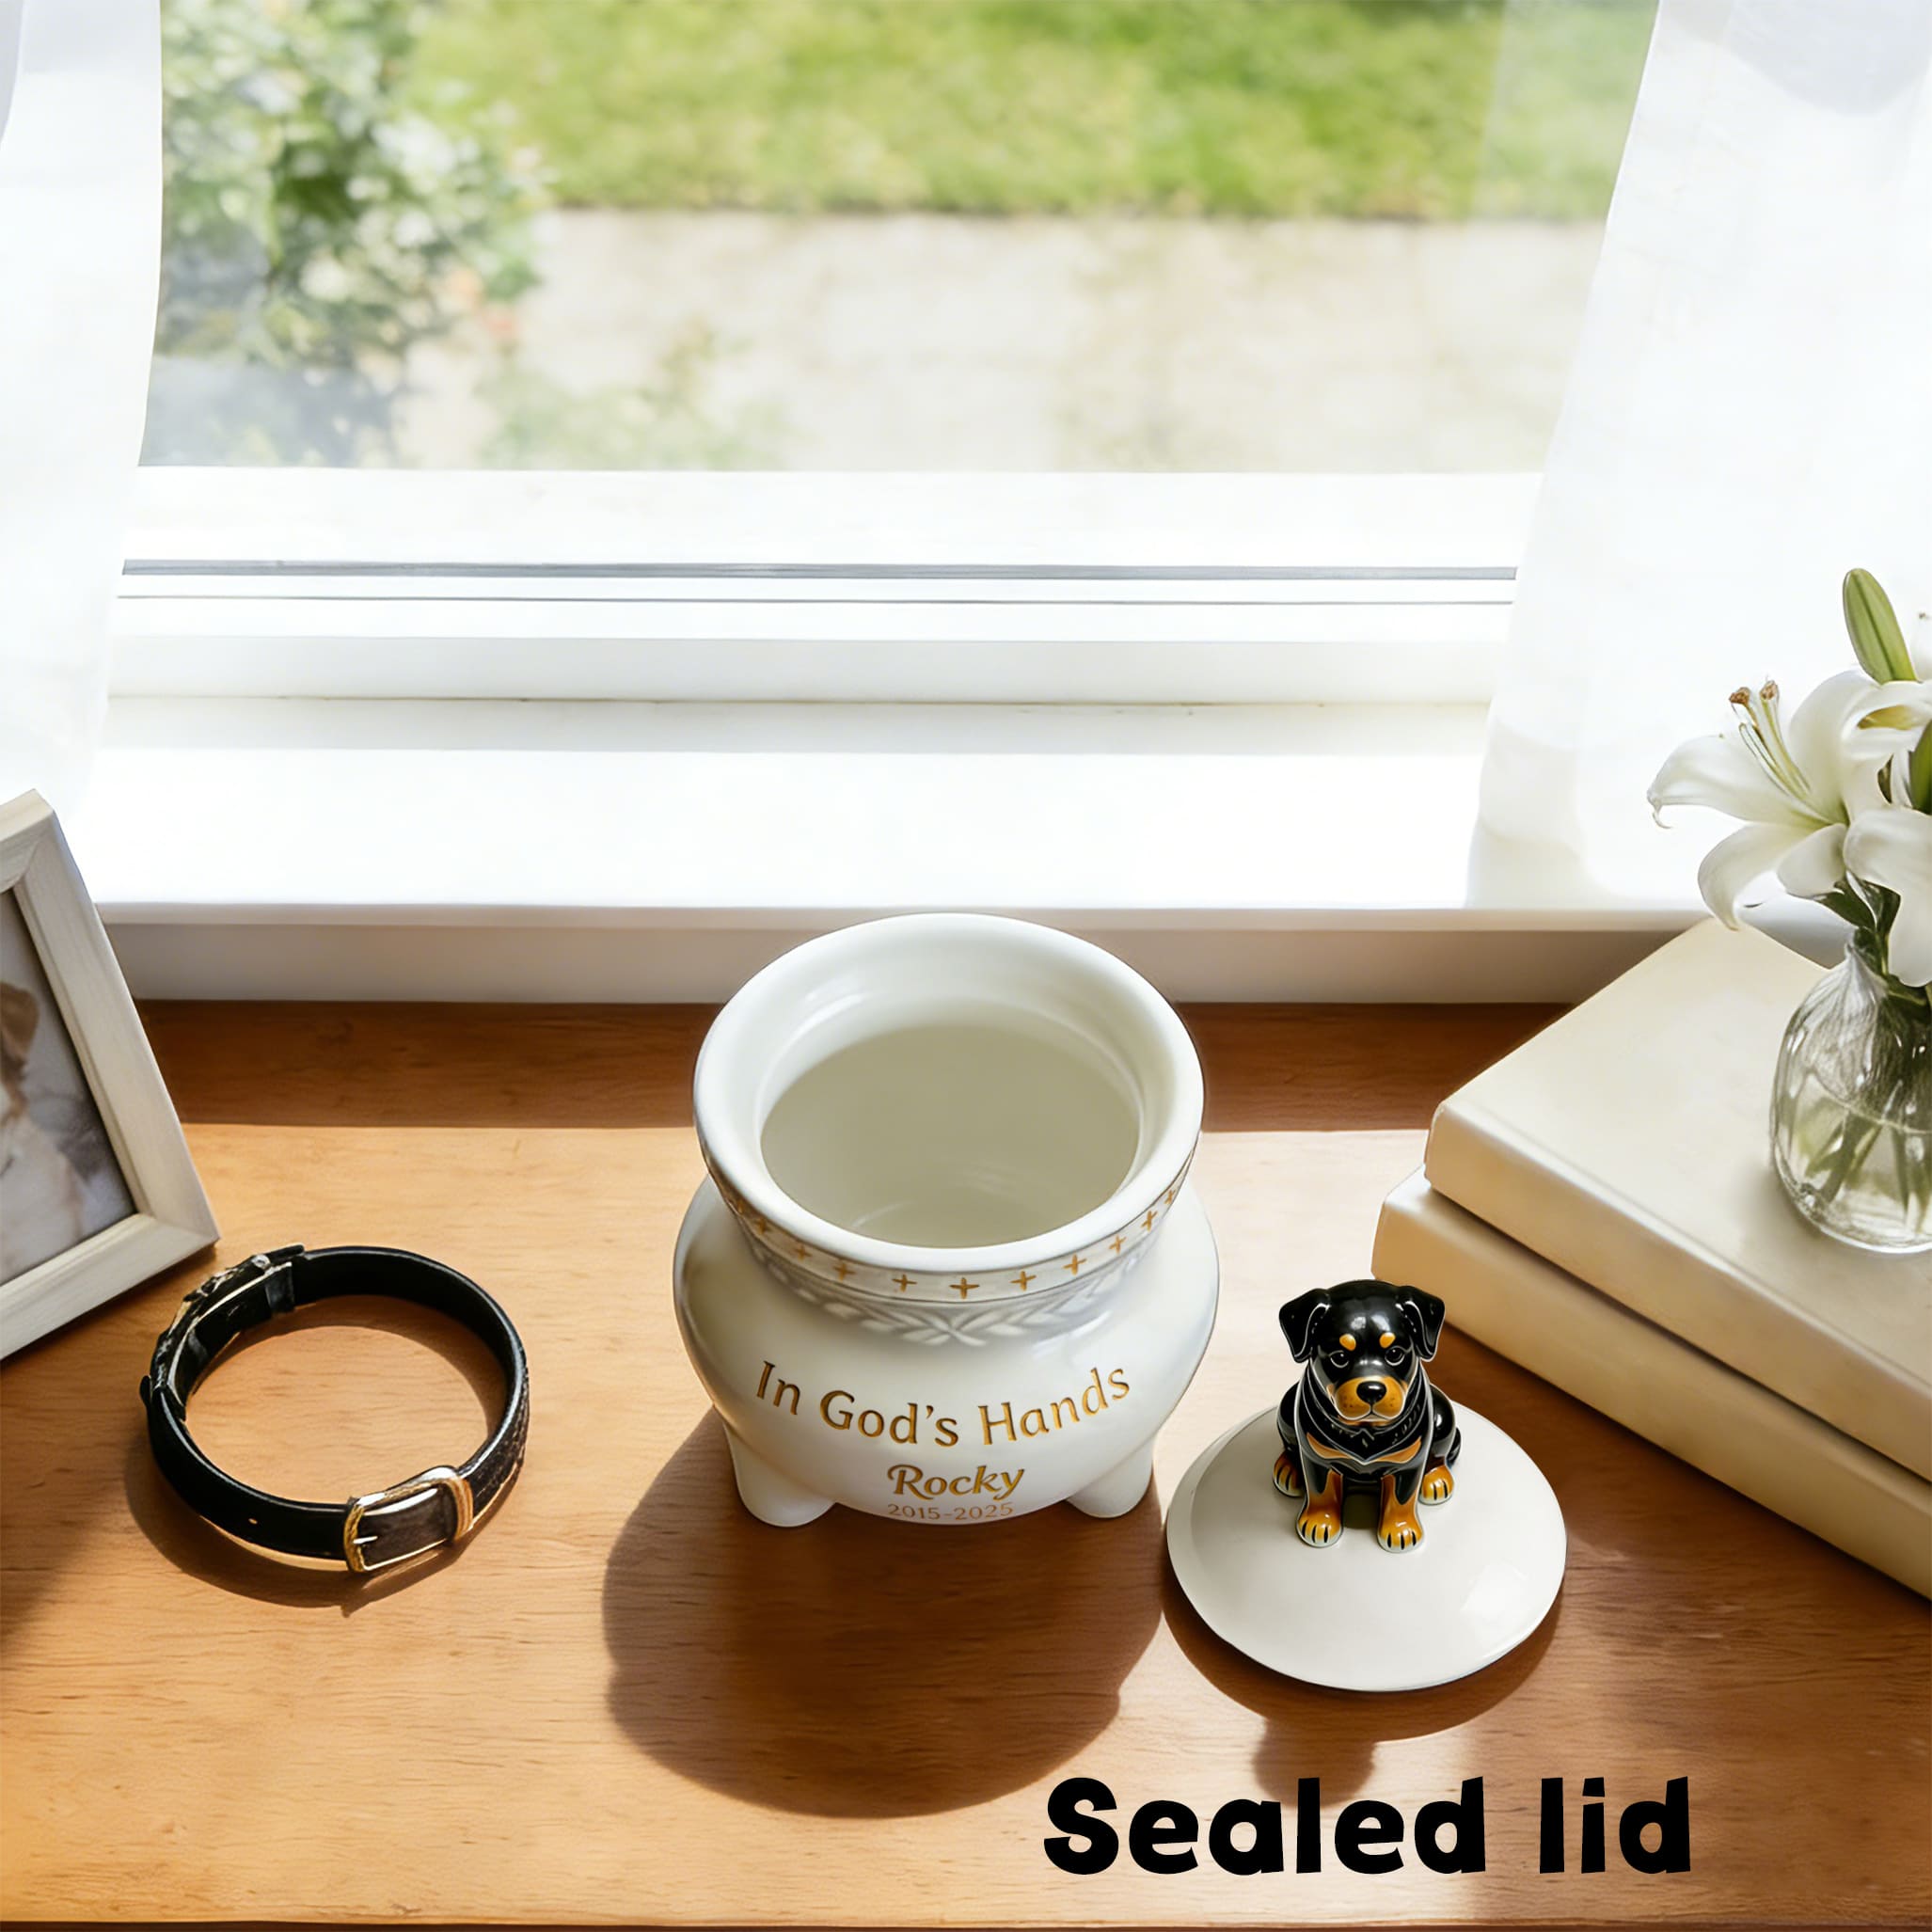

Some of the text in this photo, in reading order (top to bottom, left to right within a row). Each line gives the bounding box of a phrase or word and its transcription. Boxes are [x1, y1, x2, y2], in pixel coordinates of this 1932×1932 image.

[755, 1360, 1131, 1448] In God's Hands
[887, 1464, 1025, 1500] Rocky
[887, 1502, 1015, 1520] 2015-2025
